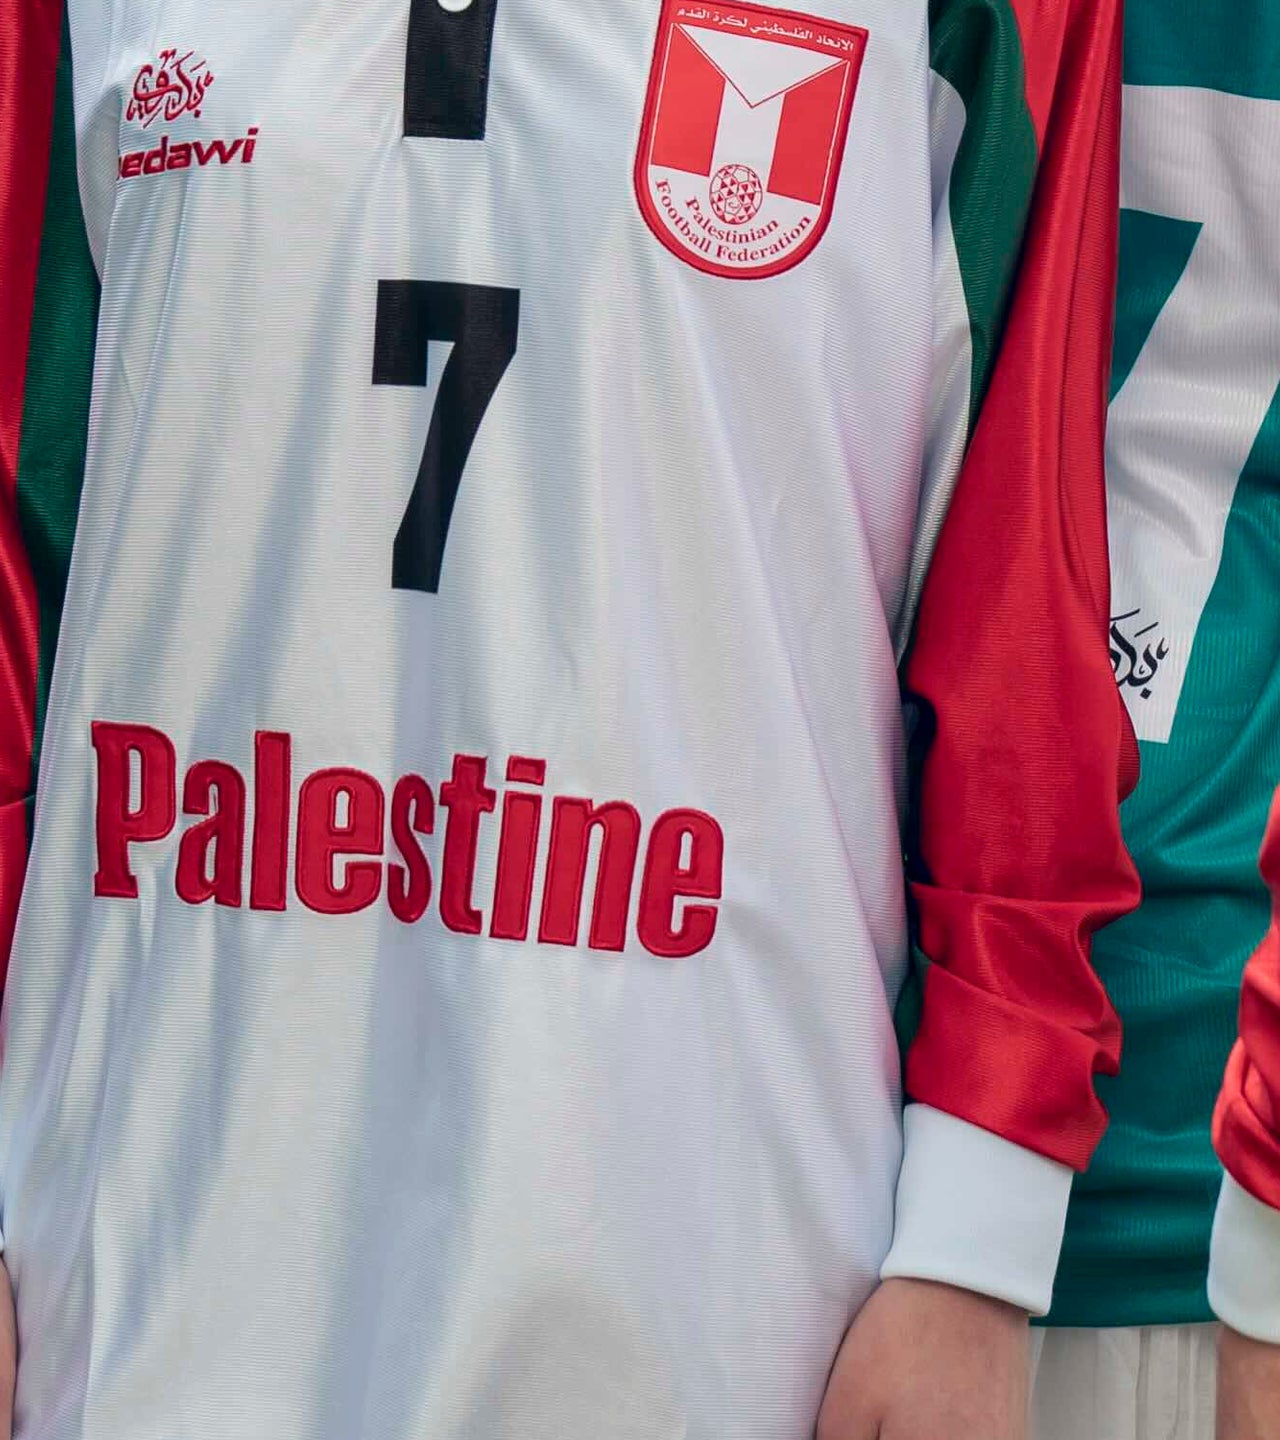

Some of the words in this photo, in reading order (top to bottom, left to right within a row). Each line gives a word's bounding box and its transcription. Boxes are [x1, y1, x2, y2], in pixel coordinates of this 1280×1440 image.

[117, 126, 259, 181] edawi
[655, 177, 712, 254] Football
[715, 215, 812, 263] Federation
[686, 195, 780, 245] Palestinian
[371, 279, 520, 594] 7
[91, 720, 724, 959] Palestine
